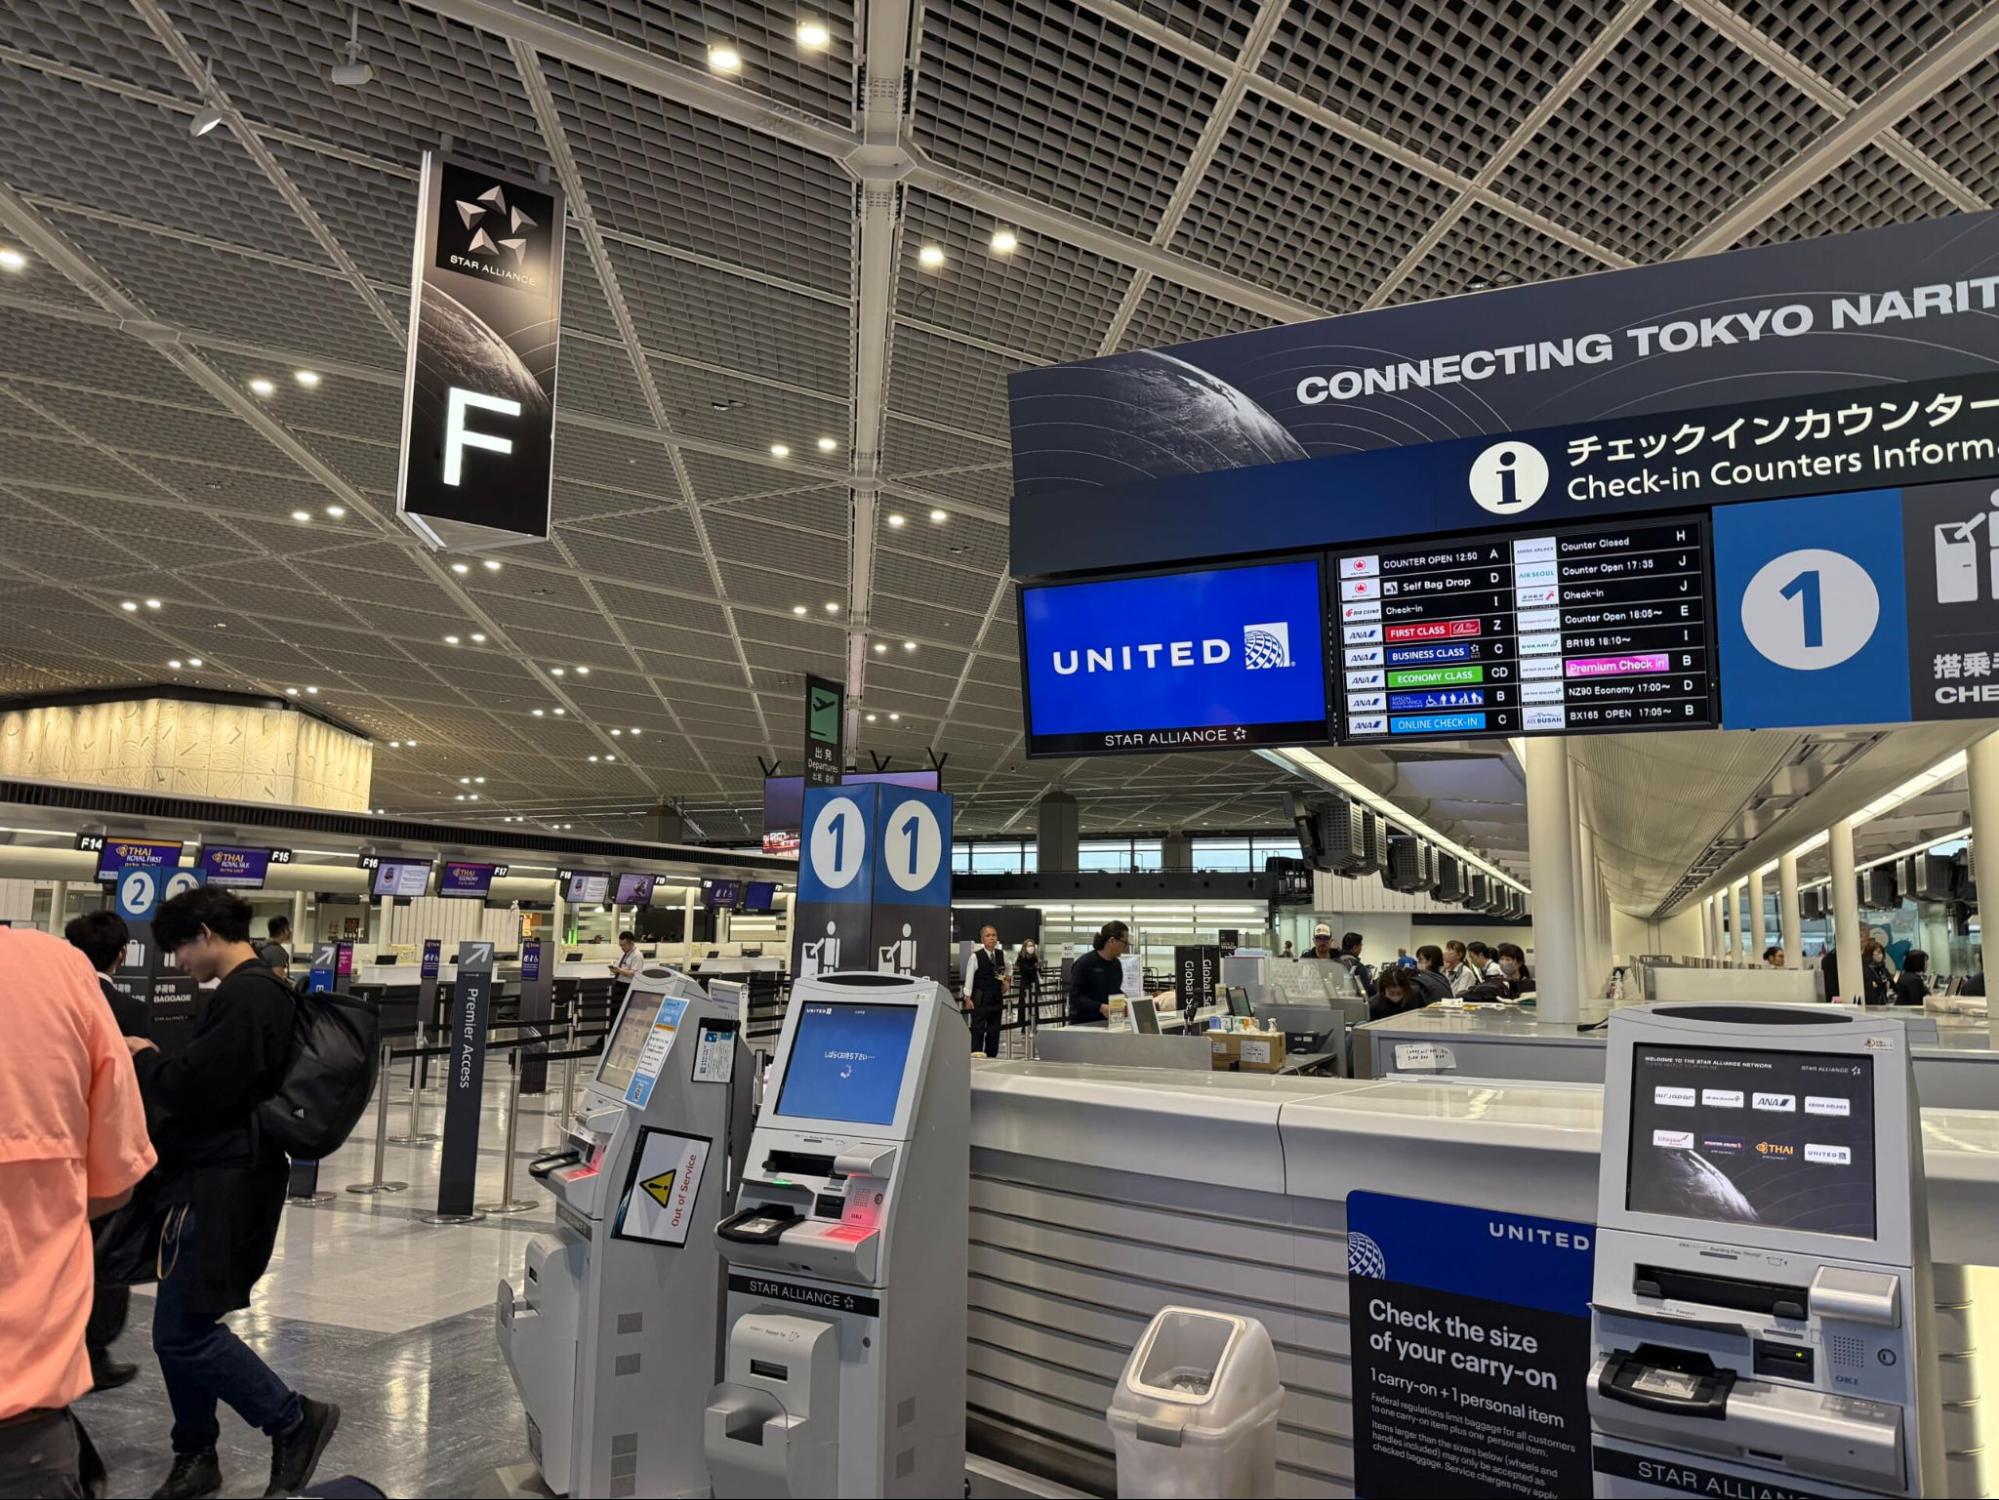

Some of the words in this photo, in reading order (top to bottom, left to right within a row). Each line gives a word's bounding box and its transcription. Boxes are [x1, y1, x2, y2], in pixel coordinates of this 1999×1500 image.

[450, 254, 479, 269] STAR
[482, 264, 537, 286] ALLIANCE
[1296, 333, 1613, 404] CONNECTING
[1627, 304, 1814, 357] TOKYO
[1831, 275, 1999, 331] NARIT
[443, 387, 521, 486] F
[1567, 392, 1999, 468] チェックインカウンター
[1567, 466, 1700, 502] Check-in
[1711, 452, 1861, 488] Counters
[1874, 438, 1999, 471] Inform
[1676, 530, 1686, 541] H
[1561, 541, 1597, 552] Counter
[1599, 537, 1630, 548] Closed
[1383, 557, 1426, 569] COUNTER
[1428, 554, 1453, 565] OPEN
[1455, 551, 1478, 562] 12:50
[1489, 549, 1499, 559] A
[1678, 555, 1687, 567] J
[1562, 565, 1598, 576] Counter
[1600, 562, 1624, 574] Open
[1627, 559, 1654, 570] 17:35
[1403, 580, 1421, 592] Self
[1424, 579, 1443, 591] Bag
[1446, 577, 1471, 589] Drop
[1490, 572, 1500, 583] D
[1680, 580, 1688, 591] J
[1563, 588, 1604, 600] Check-in
[1385, 604, 1423, 616] Check-in
[1680, 605, 1689, 616] E
[1779, 570, 1823, 648] 1
[1565, 614, 1600, 625] Counter
[1603, 611, 1626, 623] Open
[1390, 628, 1415, 638] FIRST
[1417, 625, 1445, 636] CLASS
[1493, 620, 1501, 631] Z
[1349, 631, 1368, 640] ANA
[1392, 650, 1434, 661] BUSINESS
[1436, 647, 1465, 658] CLASS
[1494, 643, 1503, 654] C
[1053, 638, 1231, 675] UNITED
[1351, 653, 1369, 662] ANA
[1682, 655, 1692, 666] B
[1569, 661, 1617, 673] Premium
[1619, 658, 1653, 670] Check
[1654, 658, 1665, 668] in
[1933, 651, 1999, 679] 搭乗
[1397, 673, 1442, 683] ECONOMY
[1445, 670, 1473, 680] CLASS
[1491, 667, 1508, 679] CD
[1352, 676, 1370, 685] ANA
[1683, 680, 1693, 691] D
[1496, 691, 1505, 701] B
[1594, 684, 1634, 696] Economy
[1353, 699, 1371, 708] ANA
[1685, 704, 1694, 715] B
[1498, 714, 1506, 725] C
[1537, 716, 1562, 724] BUSAN
[1605, 708, 1632, 719] OPEN
[1354, 721, 1373, 730] ANA
[1399, 719, 1432, 730] ONLINE
[1434, 715, 1478, 728] CHECK-IN
[1105, 734, 1144, 747] STAR
[1149, 729, 1228, 746] ALLIANCE
[81, 837, 102, 849] F14
[828, 813, 845, 872] 1
[901, 816, 920, 875] 1
[128, 846, 152, 856] THAI
[223, 853, 244, 863] THAI
[272, 851, 290, 862] F15
[362, 857, 379, 869] F16
[131, 878, 145, 906] 2
[1185, 960, 1194, 995] Global
[1203, 959, 1212, 993] Global
[153, 994, 192, 1003] BAGGAGE
[463, 988, 479, 1046] Premier
[459, 1045, 474, 1088] Access
[1758, 1097, 1779, 1107] ANA
[1769, 1144, 1794, 1155] THAI
[680, 1154, 698, 1193] Service
[677, 1192, 687, 1206] of
[671, 1207, 684, 1227] Out
[1489, 1221, 1590, 1251] UNITED
[749, 1281, 778, 1296] STAR
[781, 1286, 841, 1307] ALLIANCE
[1369, 1298, 1442, 1335] Check
[1446, 1315, 1485, 1343] the
[1489, 1326, 1538, 1354] size
[1370, 1331, 1392, 1352] of
[1395, 1339, 1446, 1365] your
[1450, 1352, 1558, 1390] carry-on
[1835, 1374, 1859, 1386] OKI
[1370, 1367, 1376, 1381] 1
[1378, 1372, 1437, 1397] carry-on
[1440, 1388, 1449, 1398] +
[1451, 1387, 1458, 1402] 1
[1460, 1393, 1526, 1419] personal
[1528, 1405, 1565, 1428] item
[1371, 1392, 1400, 1407] Federal
[1400, 1402, 1444, 1419] regulations
[1445, 1411, 1463, 1424] limit
[1464, 1416, 1502, 1434] baggage
[1503, 1426, 1515, 1437] for
[1516, 1430, 1527, 1440] all
[1528, 1434, 1576, 1453] customers
[1371, 1404, 1380, 1413] to
[1380, 1407, 1396, 1417] one
[1396, 1411, 1430, 1426] carry-on
[1430, 1418, 1449, 1431] item
[1449, 1425, 1467, 1436] plus
[1468, 1431, 1485, 1440] one
[1487, 1435, 1525, 1451] personal
[1371, 1420, 1394, 1433] Items
[1394, 1426, 1417, 1439] larger
[1418, 1433, 1437, 1445] than
[1438, 1439, 1452, 1449] the
[1477, 1447, 1504, 1463] below
[1504, 1455, 1540, 1473] (wheels
[1540, 1467, 1559, 1478] and
[1372, 1430, 1403, 1447] handles
[1403, 1441, 1441, 1459] included)
[1442, 1452, 1460, 1464] may
[1461, 1457, 1479, 1470] only
[1480, 1460, 1491, 1471] be
[1492, 1465, 1534, 1483] accepted
[1534, 1478, 1546, 1487] as
[1372, 1443, 1405, 1458] checked
[1405, 1451, 1444, 1469] baggage.
[1444, 1462, 1476, 1479] Service
[1476, 1471, 1512, 1489] charges
[1512, 1483, 1532, 1496] may
[1637, 1461, 1697, 1490] STAR
